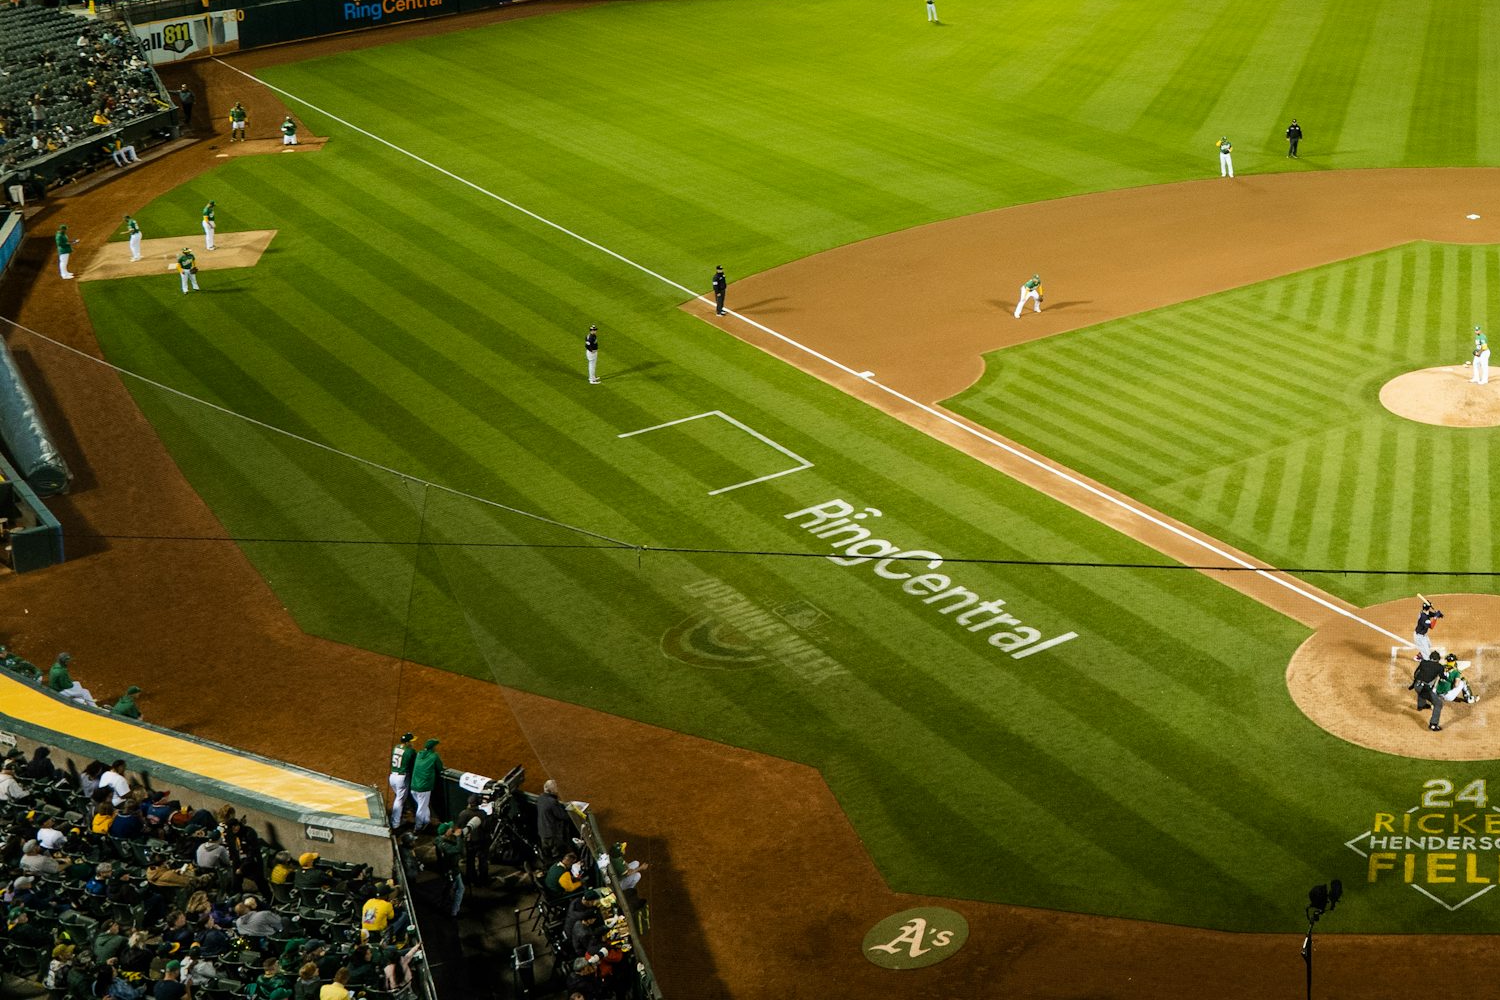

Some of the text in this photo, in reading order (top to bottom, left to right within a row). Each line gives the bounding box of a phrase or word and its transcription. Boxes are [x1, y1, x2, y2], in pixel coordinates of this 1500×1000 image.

[223, 10, 245, 22] 330
[138, 23, 190, 52] all 811
[784, 498, 1079, 660] RingCentral
[392, 755, 402, 768] 51
[1422, 778, 1488, 808] 24
[868, 918, 954, 958] A's
